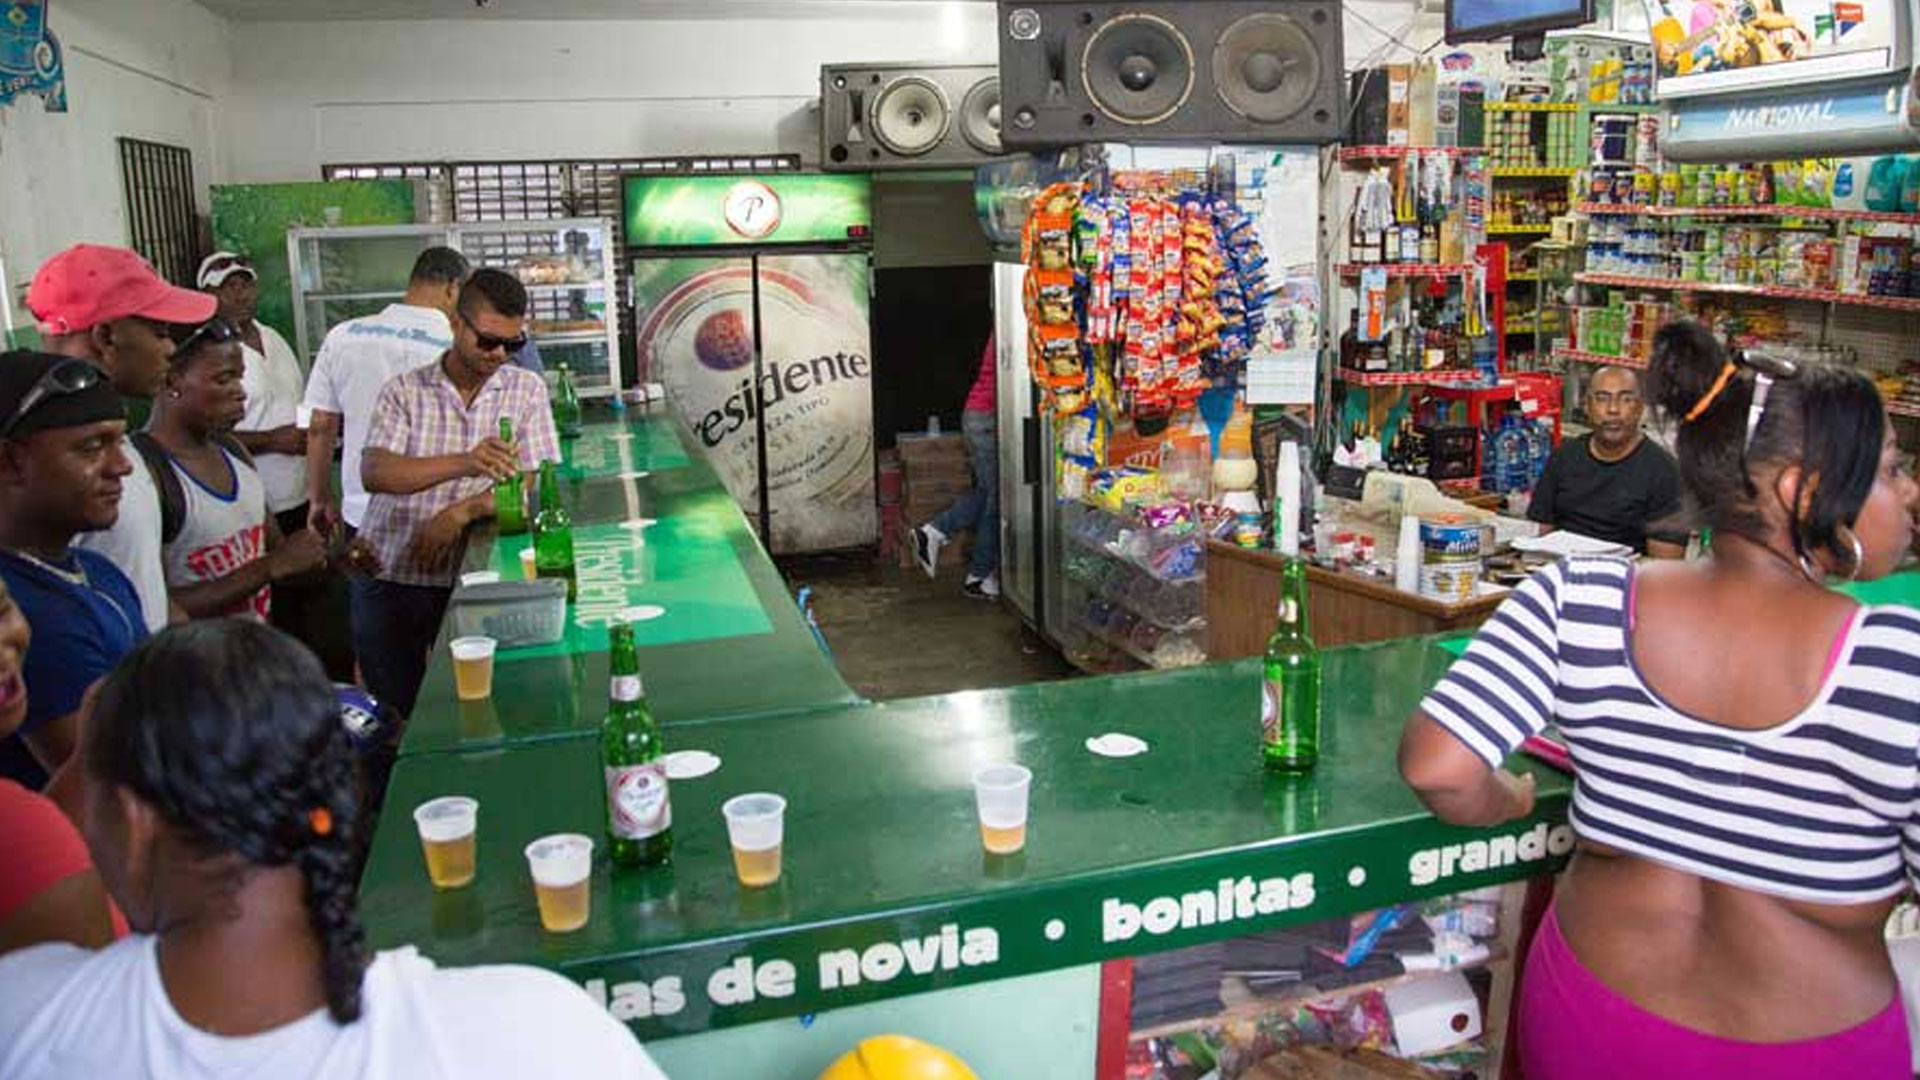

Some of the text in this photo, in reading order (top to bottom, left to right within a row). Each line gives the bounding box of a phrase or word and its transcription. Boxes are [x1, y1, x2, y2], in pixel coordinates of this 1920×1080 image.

[1102, 872, 1316, 943] bonitas
[706, 958, 796, 1005] de
[819, 924, 999, 991] novia
